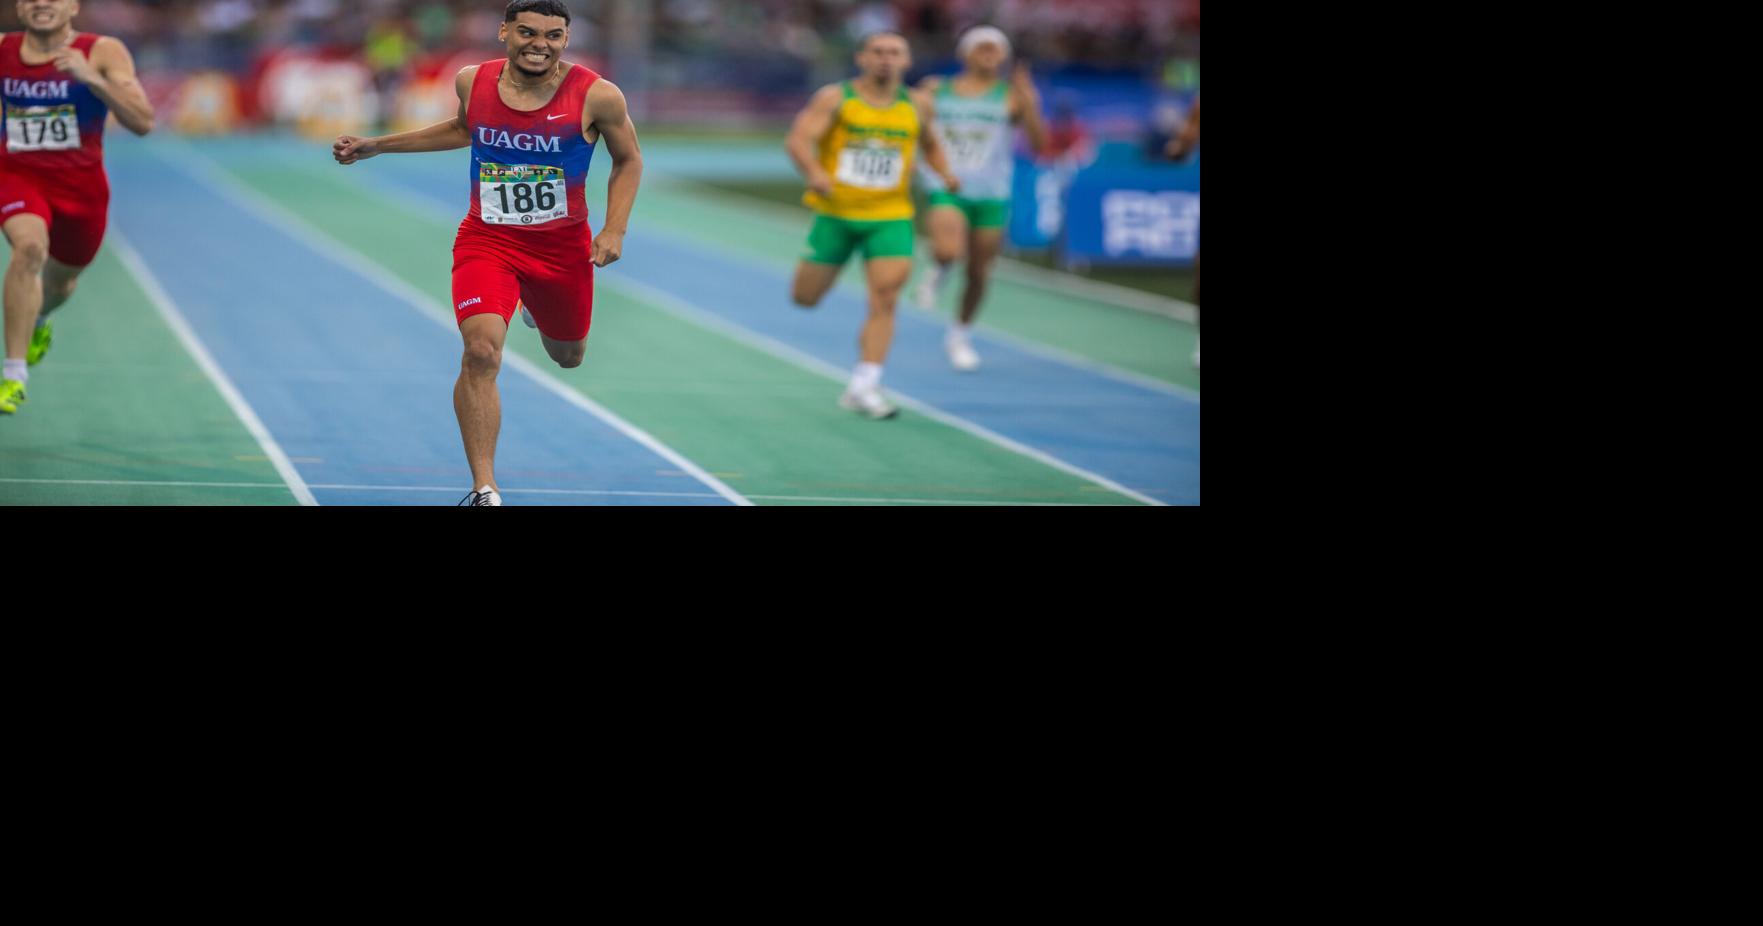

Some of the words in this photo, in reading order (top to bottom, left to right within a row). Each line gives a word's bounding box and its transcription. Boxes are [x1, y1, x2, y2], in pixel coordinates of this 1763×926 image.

[4, 78, 68, 98] UAGM
[20, 118, 68, 144] 179
[478, 127, 562, 153] UAGM
[493, 182, 556, 214] 186
[458, 296, 482, 310] UAGM
